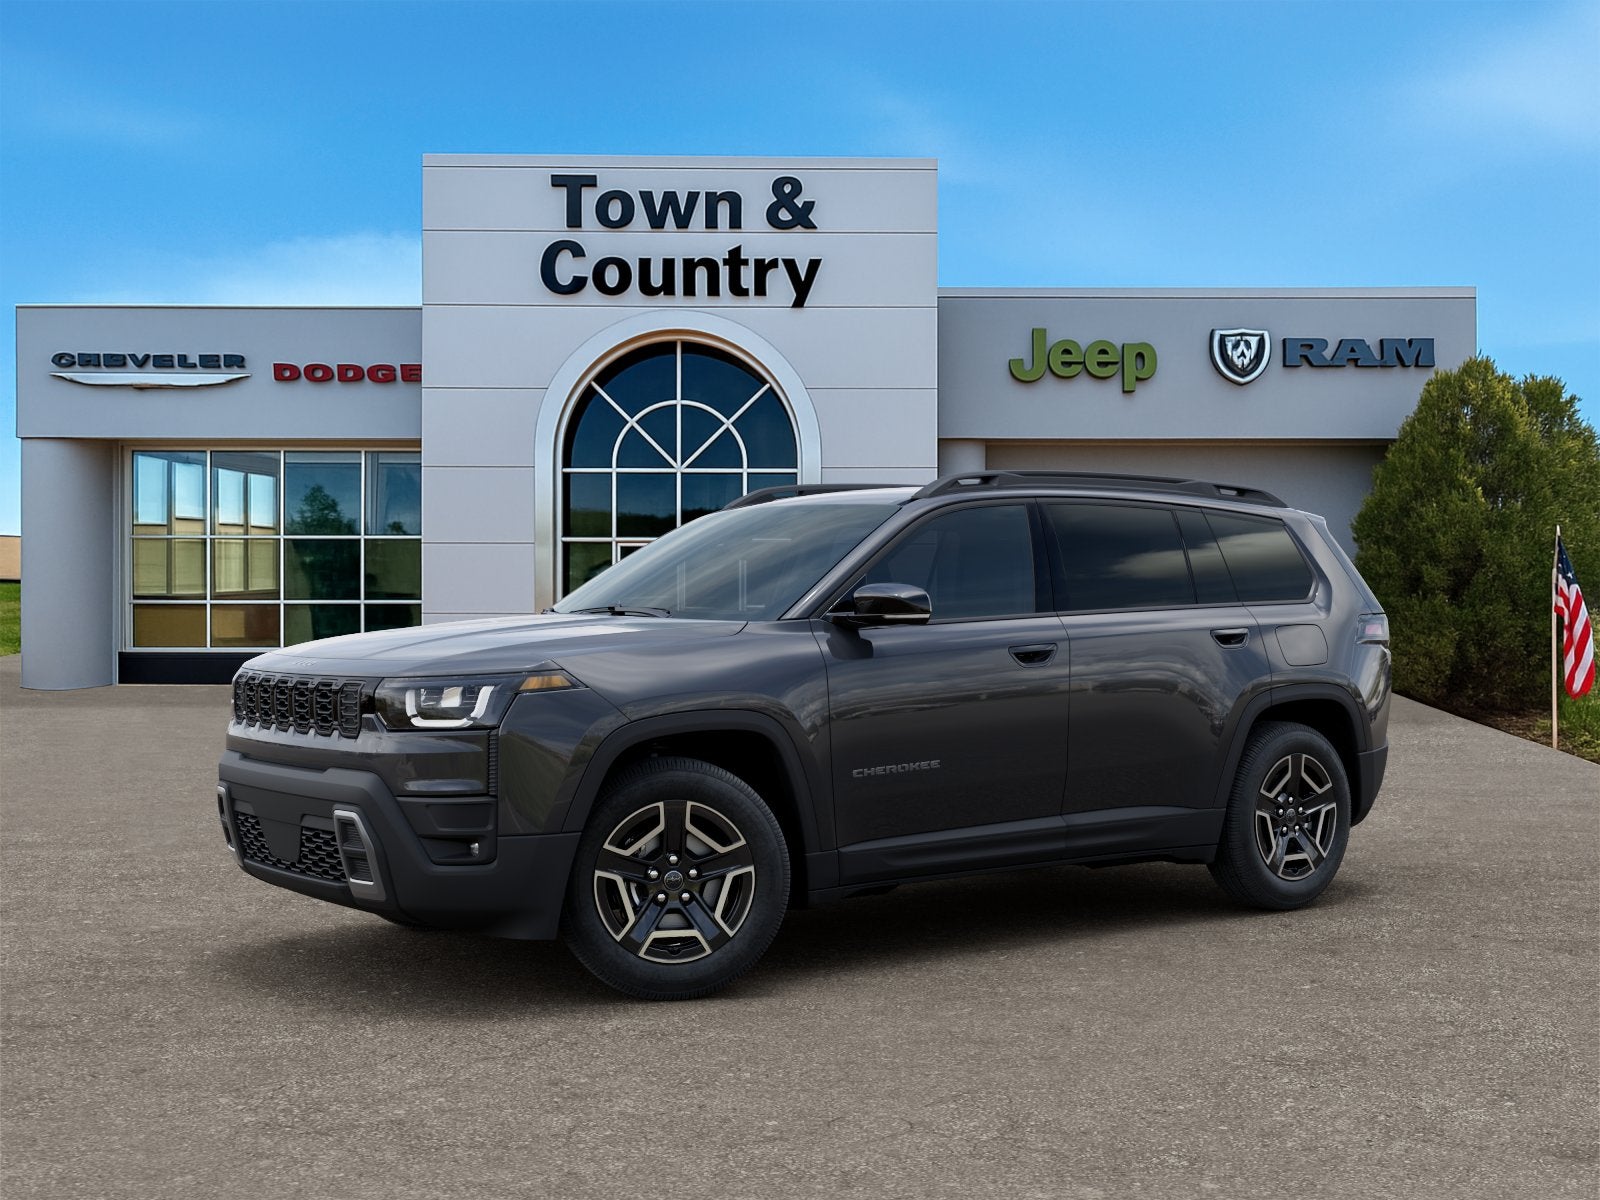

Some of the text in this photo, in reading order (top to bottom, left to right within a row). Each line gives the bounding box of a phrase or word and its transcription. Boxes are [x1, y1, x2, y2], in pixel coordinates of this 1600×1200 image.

[551, 174, 818, 230] Town &
[540, 240, 822, 308] Country
[273, 363, 422, 383] DODGE
[1009, 328, 1157, 392] Jeep
[1283, 337, 1435, 368] RAM
[852, 759, 941, 778] CHEROKEE
